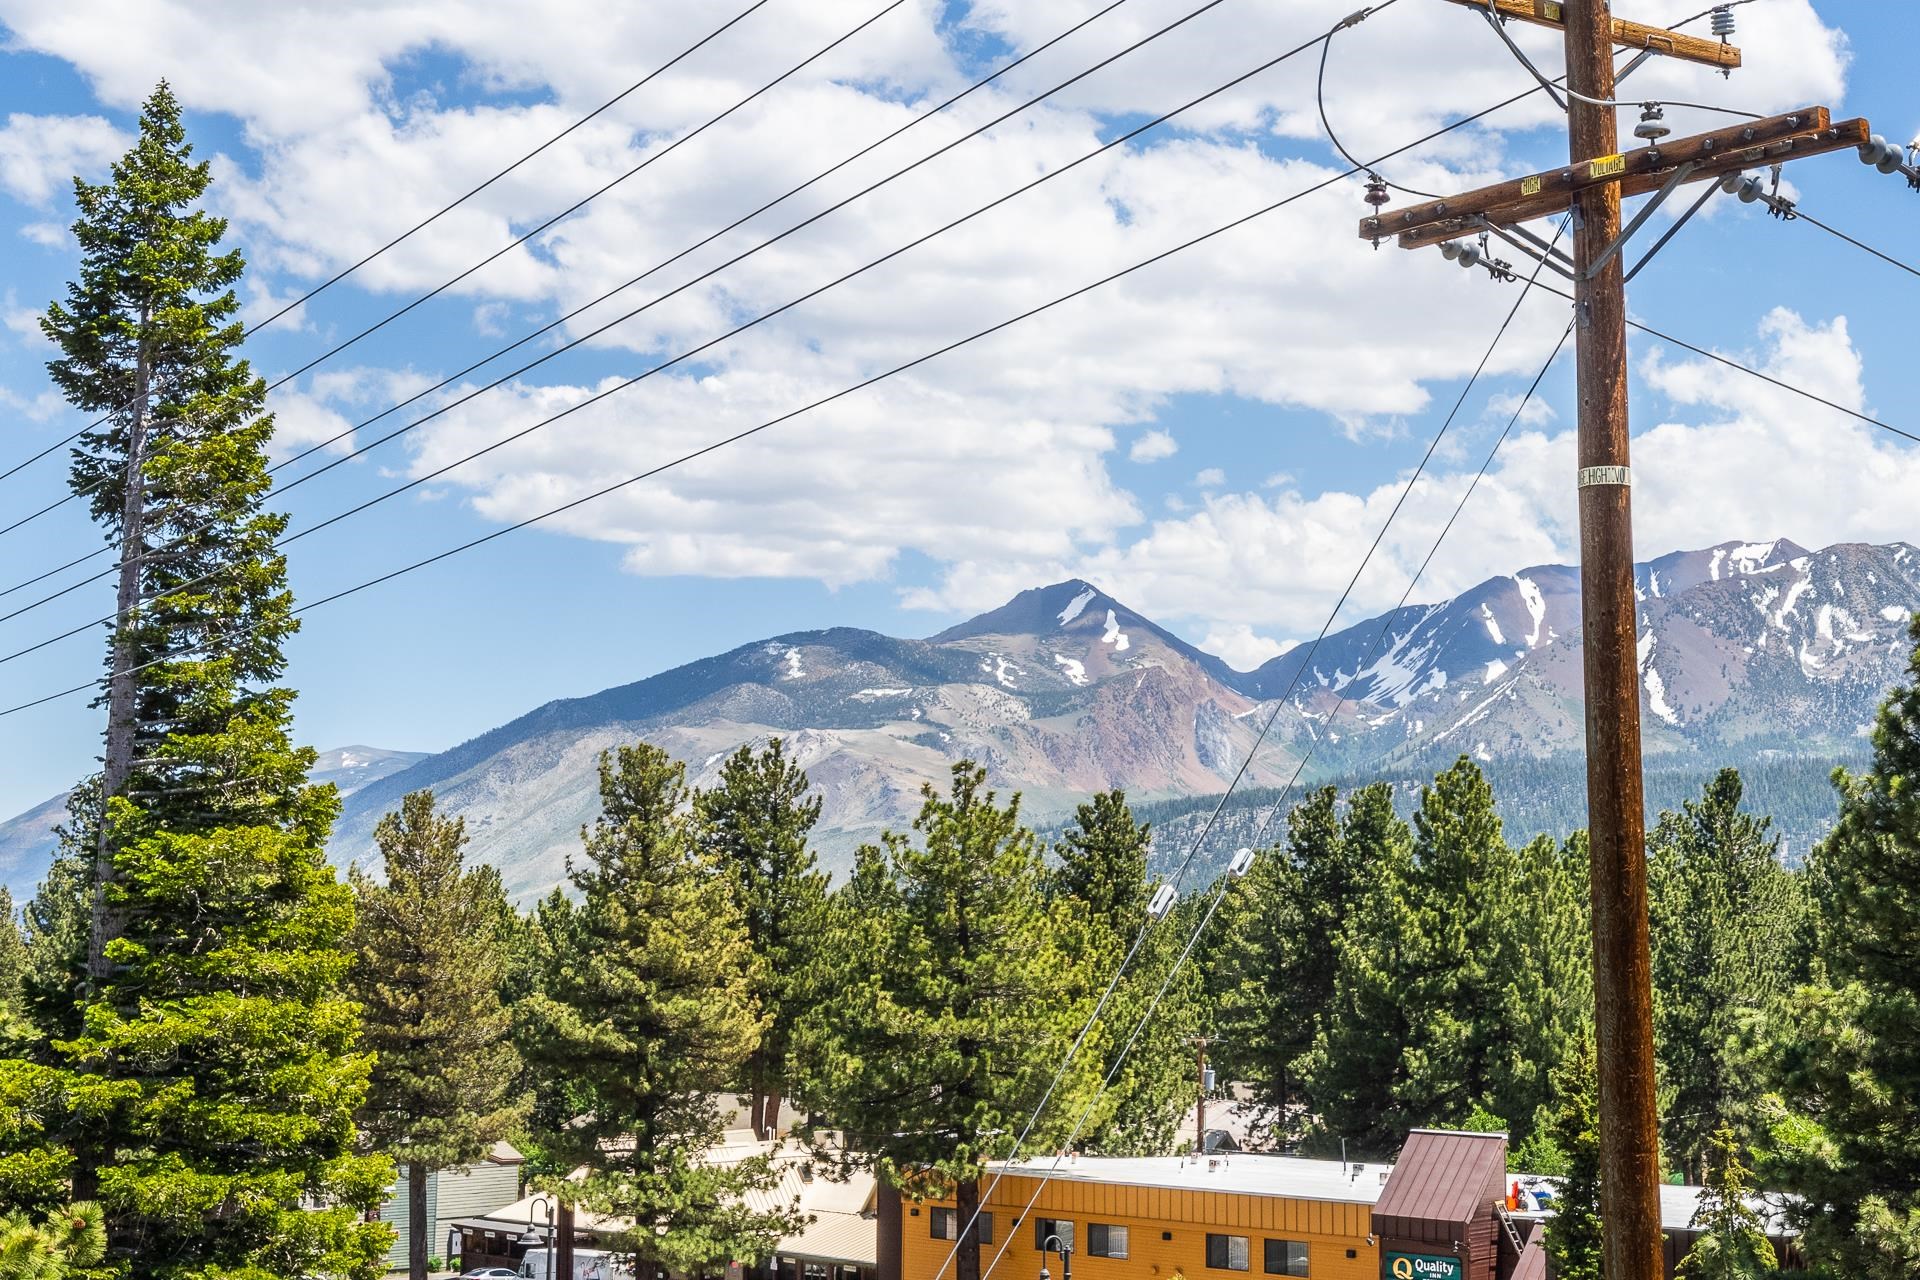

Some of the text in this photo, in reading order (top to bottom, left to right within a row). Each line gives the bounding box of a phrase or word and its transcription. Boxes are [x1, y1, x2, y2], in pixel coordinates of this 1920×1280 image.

[1522, 154, 1625, 194] HIGH VOLTAGE
[1589, 467, 1608, 484] HIGH
[1392, 1257, 1414, 1280] Q
[1415, 1258, 1454, 1276] Quality
